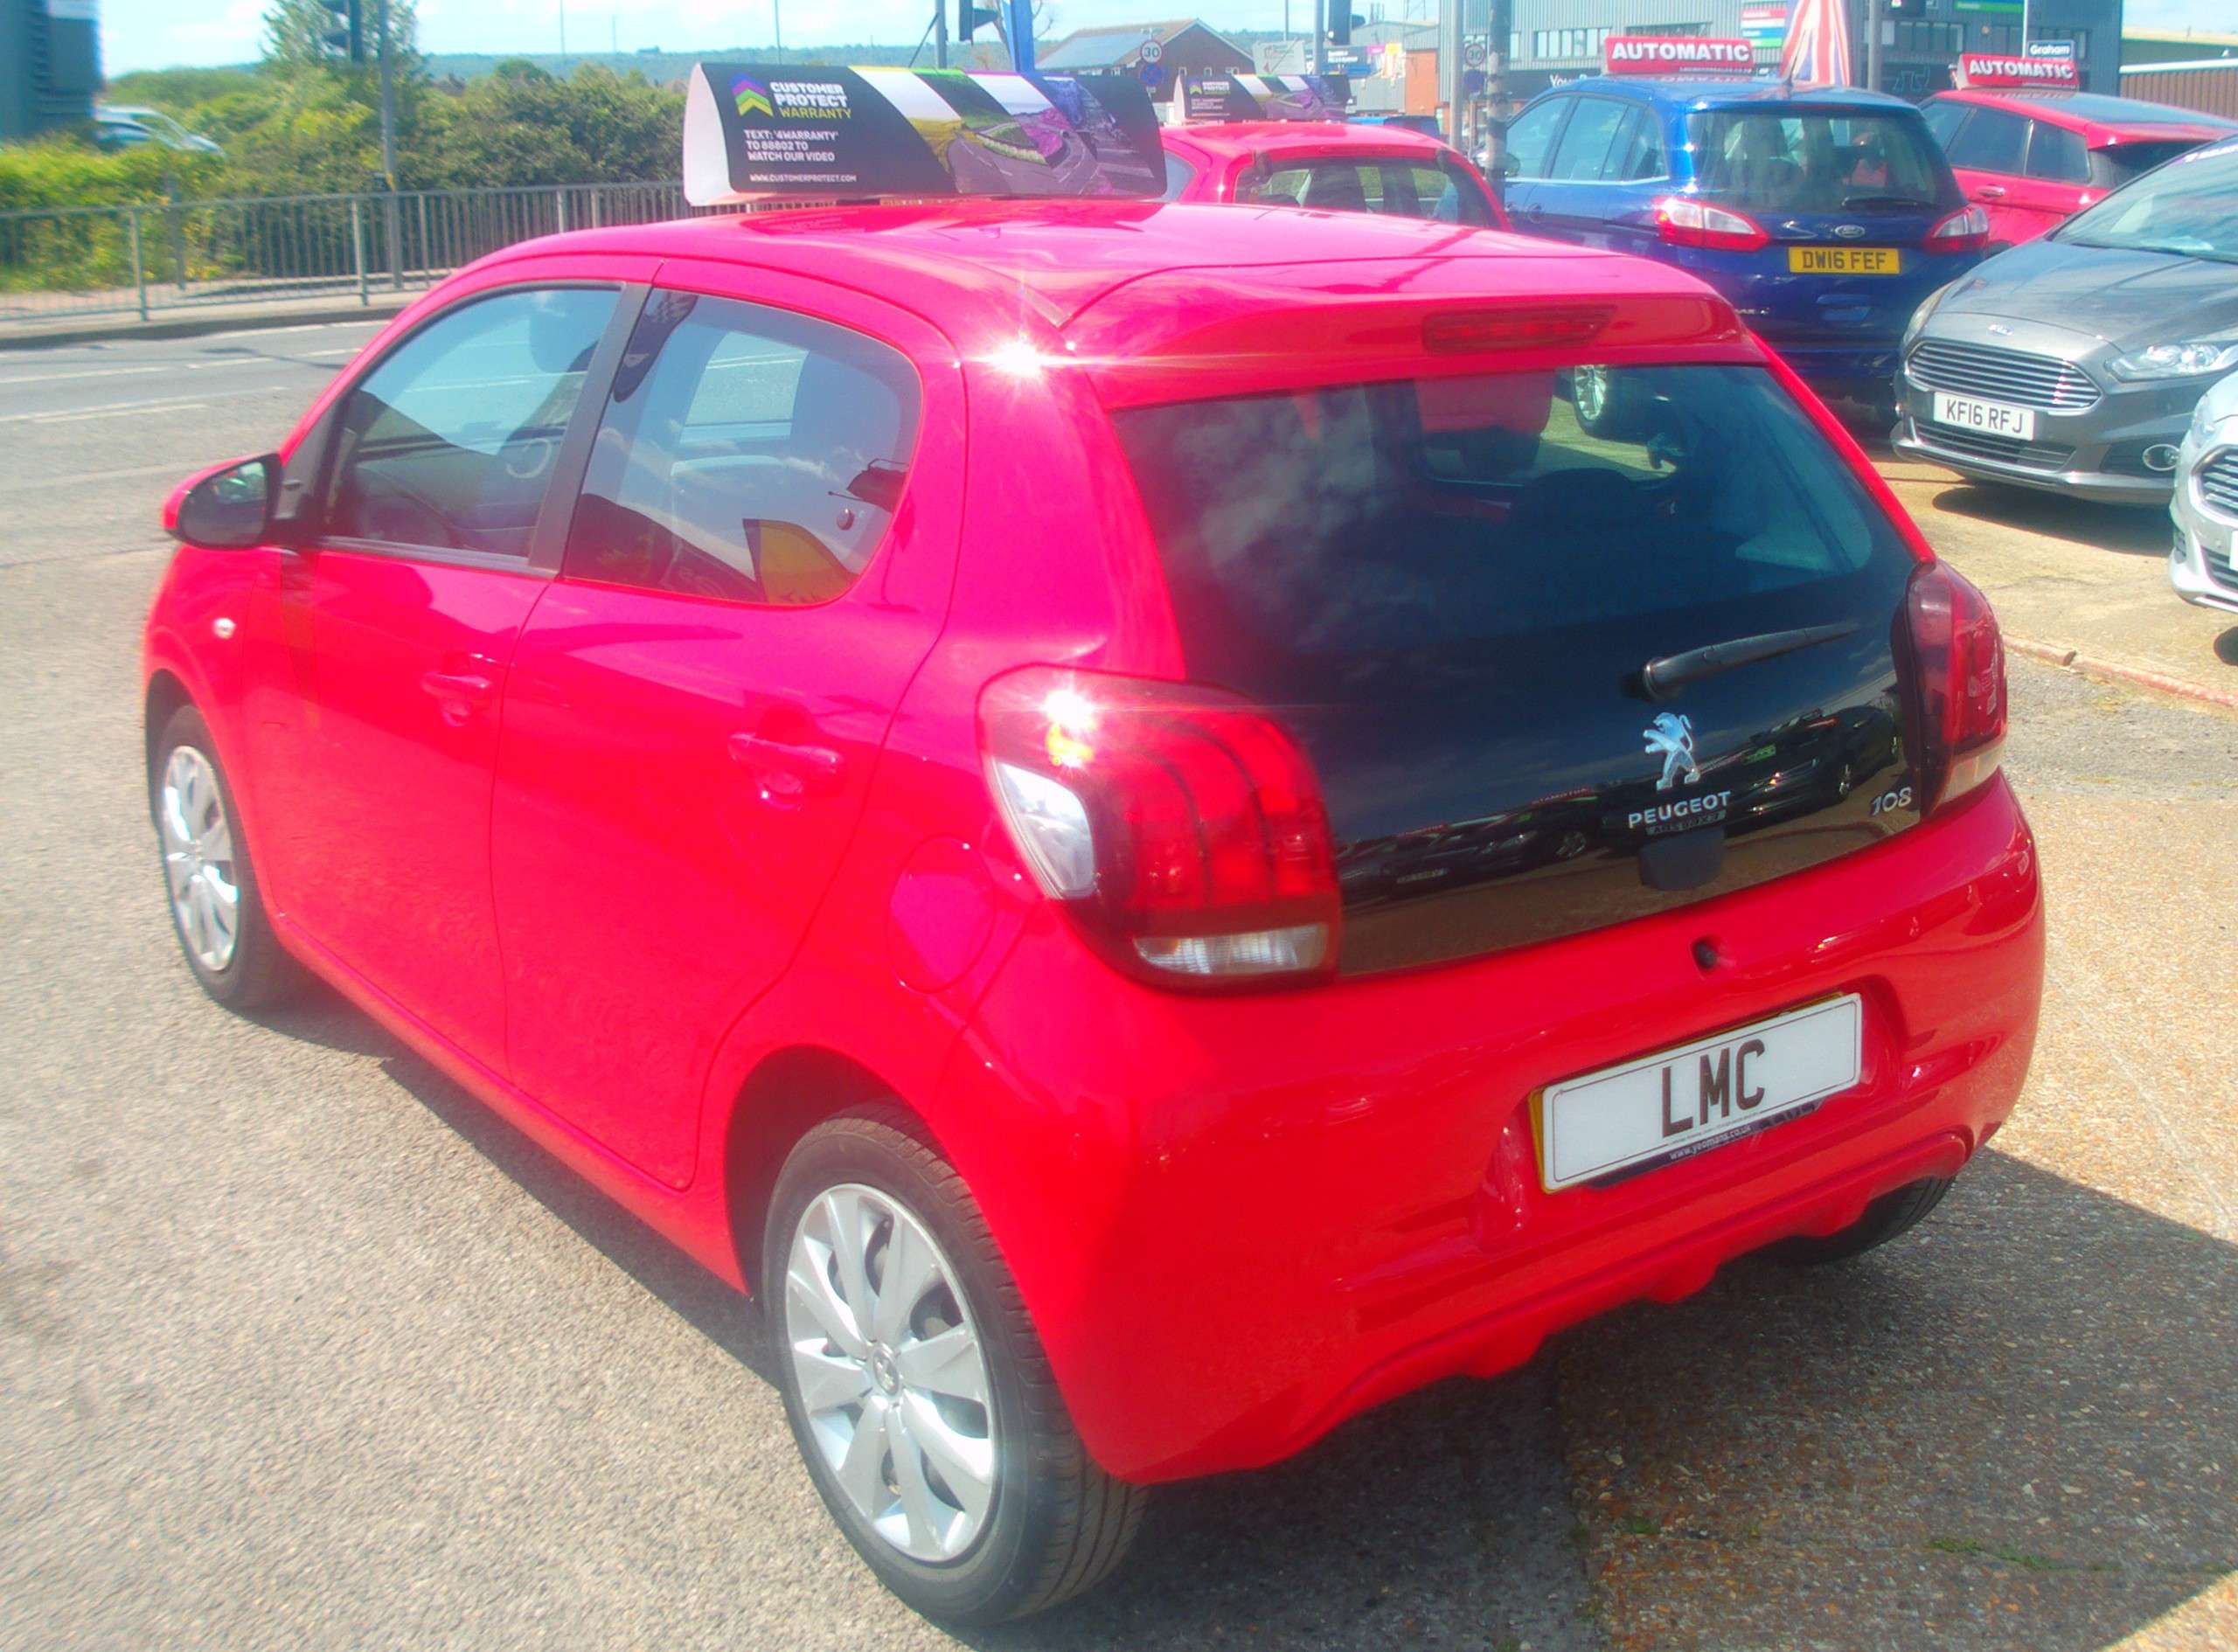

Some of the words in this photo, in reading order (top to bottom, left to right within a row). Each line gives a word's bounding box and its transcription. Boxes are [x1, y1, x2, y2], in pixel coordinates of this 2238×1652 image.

[1144, 47, 1160, 57] 30
[1611, 42, 1749, 62] AUTOMATIC
[2029, 44, 2070, 56] Graham
[1969, 59, 2074, 80] AUTOMATIC
[769, 82, 844, 94] CUSTOMER
[774, 93, 848, 108] PROTECT
[779, 108, 851, 118] WARRANTY
[743, 129, 772, 140] TEXT:
[746, 141, 761, 150] TO
[794, 142, 809, 150] TO
[747, 151, 783, 161] WATCH
[783, 152, 804, 162] OUR
[805, 152, 836, 162] VIDEO
[1802, 251, 1845, 269] DW16
[1850, 252, 1887, 270] FEF
[1946, 399, 1983, 427] KF16
[1988, 406, 2024, 434] RFJ
[1873, 787, 1912, 816] 108
[1628, 790, 1731, 829] PEUGEOT
[1662, 1038, 1765, 1138] LMC
